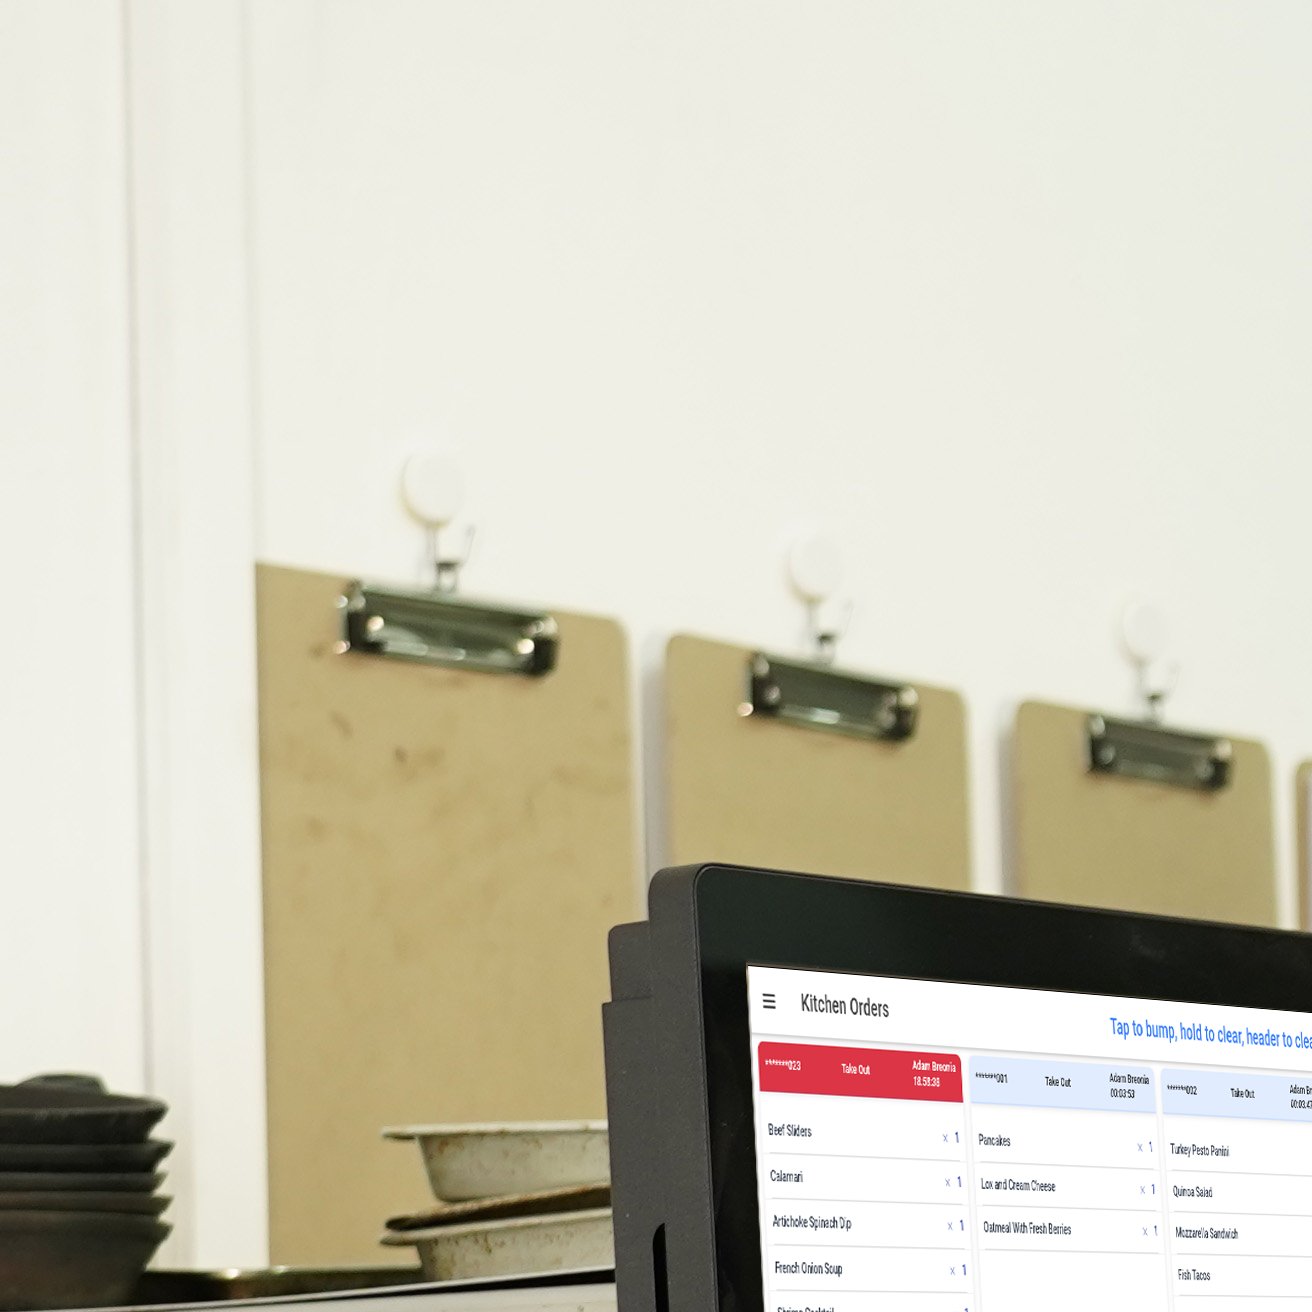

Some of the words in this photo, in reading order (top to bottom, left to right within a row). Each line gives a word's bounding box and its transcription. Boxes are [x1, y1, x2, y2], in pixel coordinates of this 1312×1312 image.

[801, 993, 846, 1014] Kitchen
[850, 997, 889, 1017] Orders
[1110, 1018, 1129, 1040] Tap
[1132, 1020, 1143, 1036] to
[1146, 1019, 1177, 1043] bump,
[1180, 1022, 1202, 1041] hold
[1204, 1026, 1214, 1042] to
[1218, 1026, 1244, 1047] clear,
[1246, 1027, 1280, 1046] header
[1282, 1032, 1292, 1047] to
[841, 1063, 857, 1074] Take
[859, 1065, 870, 1075] Out
[912, 1060, 930, 1070] Adam
[1045, 1076, 1059, 1086] Take
[1061, 1078, 1071, 1087] Out
[1110, 1073, 1126, 1083] Adam
[1231, 1088, 1244, 1098] Take
[1245, 1089, 1255, 1098] Out
[1290, 1084, 1304, 1094] Adam
[768, 1123, 785, 1136] Beef
[787, 1124, 812, 1137] Sliders
[979, 1133, 1010, 1146] Pancakes
[1170, 1143, 1191, 1157] Turkey
[1192, 1144, 1209, 1156] Pesto
[1211, 1145, 1229, 1156] Panini
[770, 1170, 803, 1182] Calamari
[981, 1178, 993, 1189] Lox
[995, 1179, 1007, 1190] and
[1009, 1179, 1030, 1190] Cream
[1031, 1180, 1056, 1192] Cheese
[1173, 1185, 1194, 1198] Quinoa
[1196, 1186, 1212, 1197] Salad
[773, 1215, 808, 1228] Artichoke
[809, 1216, 838, 1231] Spinach
[839, 1217, 852, 1231] Dip
[984, 1221, 1011, 1233] Oatmeal
[1012, 1222, 1028, 1233] With
[1029, 1222, 1047, 1234] Fresh
[1048, 1223, 1071, 1235] Berries
[1176, 1227, 1208, 1238] Mozzarella
[1210, 1228, 1238, 1239] Sandwich
[775, 1261, 800, 1274] French
[801, 1262, 823, 1274] Onion
[825, 1262, 842, 1277] Soup
[1178, 1269, 1191, 1280] Fish
[1192, 1269, 1210, 1281] Tacos
